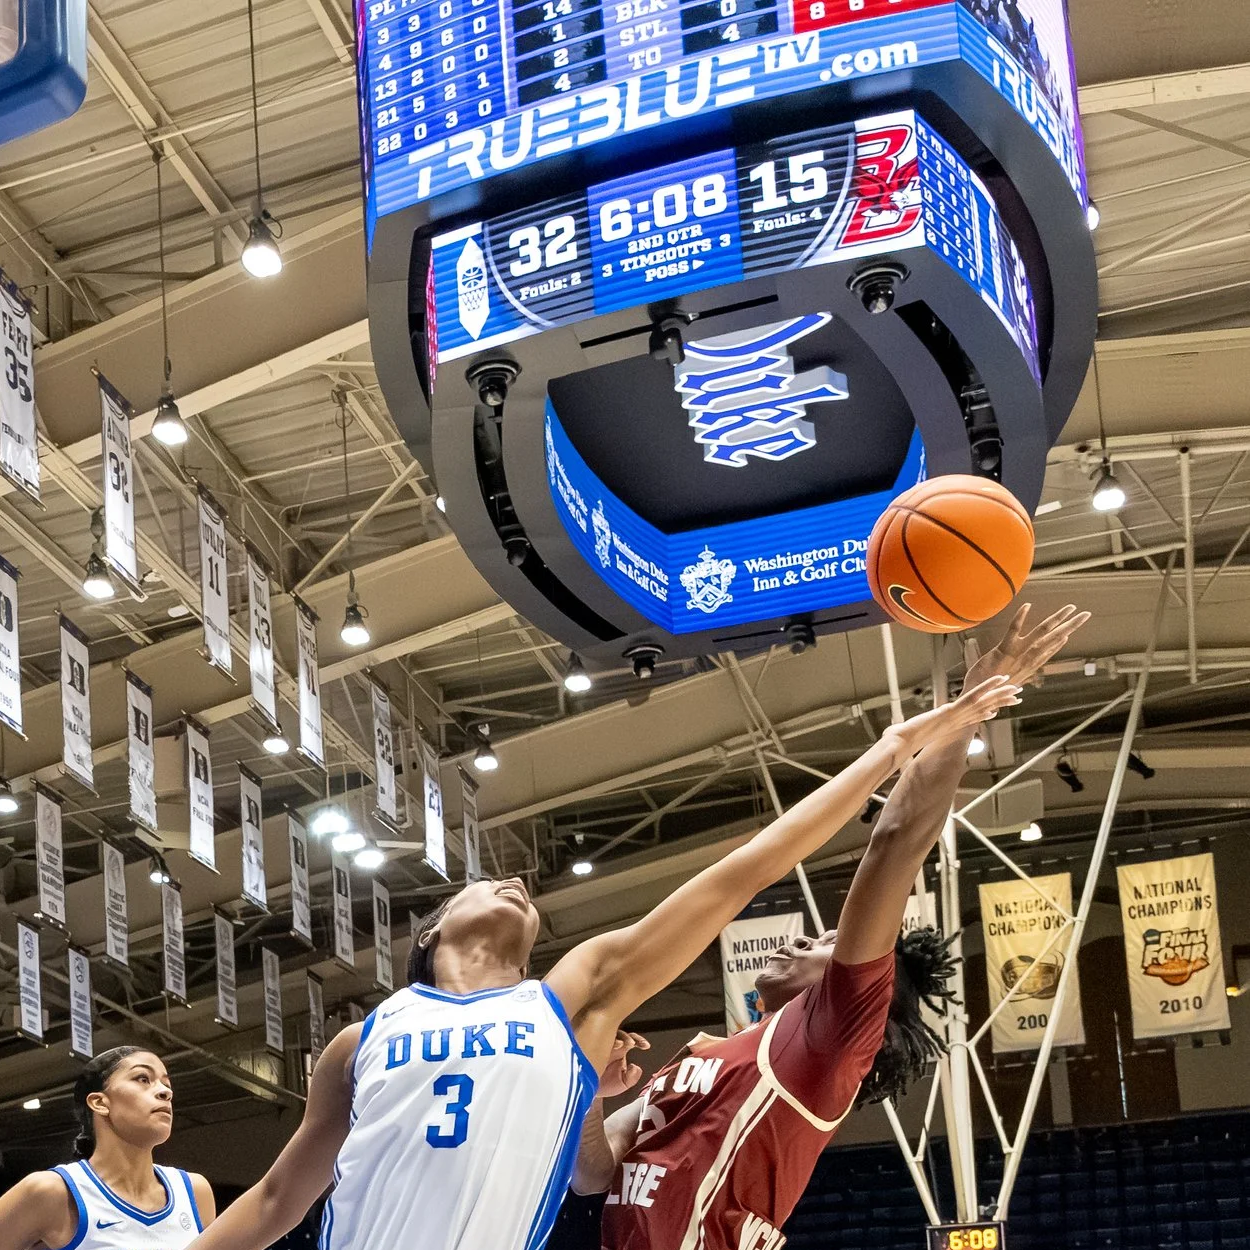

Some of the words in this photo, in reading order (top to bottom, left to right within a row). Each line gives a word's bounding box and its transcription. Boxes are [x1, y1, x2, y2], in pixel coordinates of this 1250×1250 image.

[378, 28, 390, 45] 3
[408, 15, 420, 32] 3
[439, 1, 452, 19] 0
[543, 2, 572, 21] 14
[378, 54, 392, 71] 4
[410, 41, 422, 59] 9
[441, 29, 454, 46] 6
[473, 16, 487, 34] 0
[553, 23, 566, 43] 1
[553, 49, 570, 67] 2
[619, 22, 668, 47] STL
[375, 79, 398, 102] 13
[411, 69, 424, 87] 2
[443, 55, 455, 73] 0
[475, 44, 488, 62] 0
[554, 72, 570, 91] 4
[629, 48, 662, 71] TO
[722, 22, 740, 42] 4
[377, 107, 400, 128] 21
[413, 96, 425, 113] 5
[444, 83, 456, 101] 2
[478, 72, 490, 89] 1
[377, 133, 402, 156] 22
[414, 123, 427, 140] 0
[446, 111, 458, 129] 3
[478, 99, 492, 117] 0
[508, 216, 578, 278] 32
[599, 173, 729, 242] 6:08
[749, 149, 829, 214] 15
[753, 210, 807, 235] Fouls:
[809, 207, 823, 222] 4
[602, 263, 614, 278] 3
[620, 242, 713, 272] TIMEOUTS
[720, 233, 732, 248] 3
[627, 231, 664, 254] 2ND
[667, 225, 704, 247] QTR
[519, 276, 569, 301] Fouls:
[571, 271, 582, 286] 2
[645, 259, 690, 283] POSS
[4, 346, 32, 403] 35
[743, 546, 839, 574] Washington
[842, 535, 871, 555] Du
[207, 555, 221, 597] 11
[752, 576, 781, 592] Inn
[783, 570, 799, 586] &
[800, 561, 839, 582] Golf
[841, 556, 868, 574] Clu
[1134, 877, 1203, 900] NATIONAL
[1128, 895, 1213, 920] CHAMPIONS
[1160, 928, 1208, 947] FINAL
[727, 956, 771, 974] CHAMP
[1142, 943, 1209, 969] FOUR
[1017, 1013, 1049, 1031] 200
[1159, 996, 1203, 1014] 2010
[385, 1021, 535, 1071] DUKE
[426, 1073, 475, 1149] 3
[949, 1229, 997, 1250] 6:08
